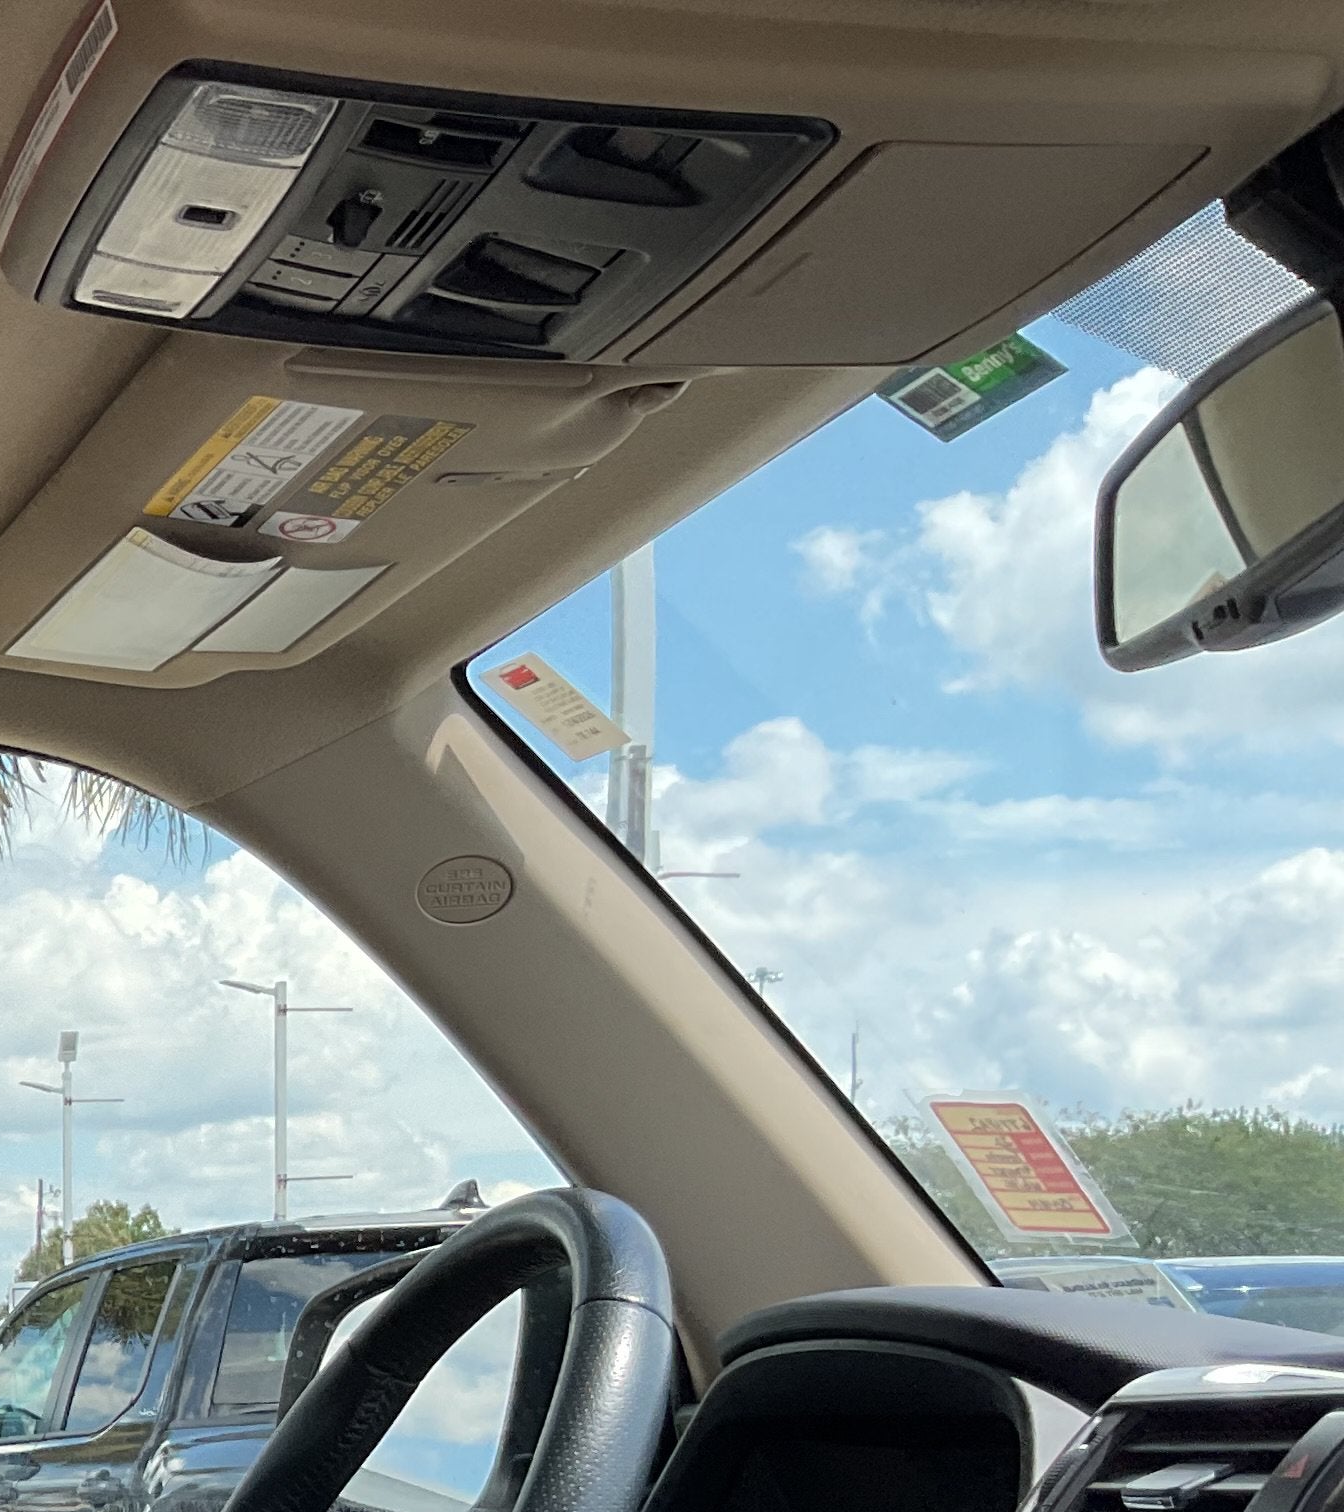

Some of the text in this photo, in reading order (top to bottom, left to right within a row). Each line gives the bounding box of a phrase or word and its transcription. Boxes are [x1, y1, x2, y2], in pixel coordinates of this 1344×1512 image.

[960, 341, 1022, 382] Benny's
[376, 434, 408, 457] OVER
[425, 880, 506, 894] CURTAIN
[431, 892, 501, 907] AIRBAG
